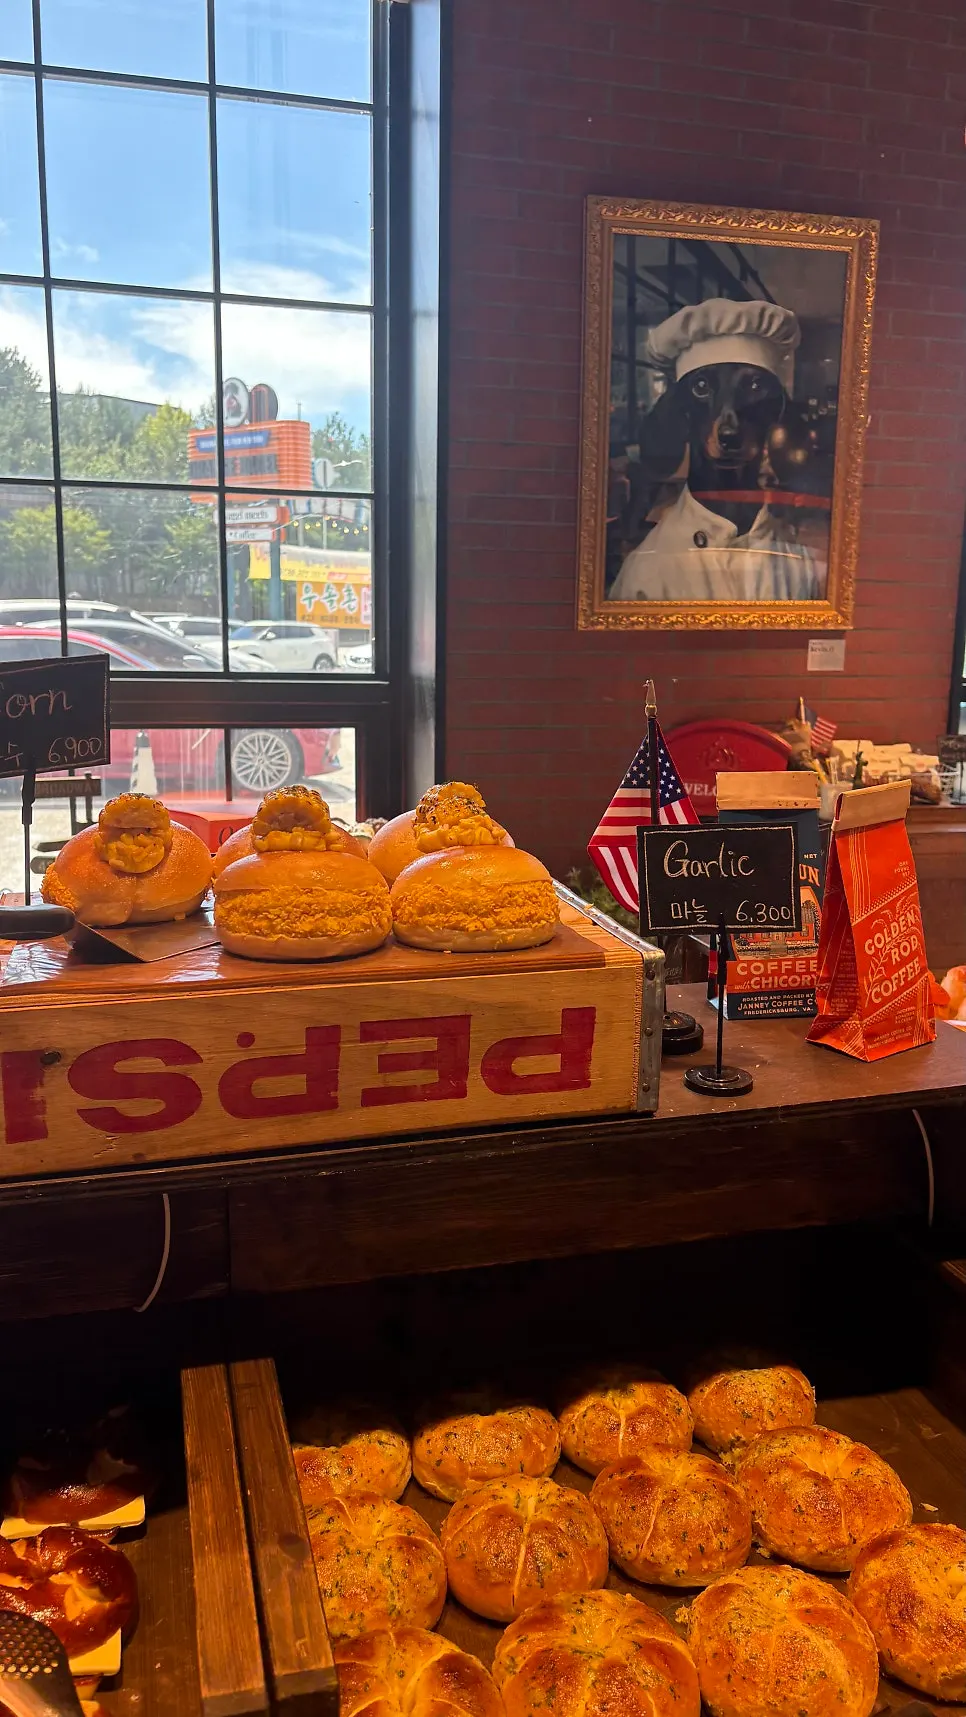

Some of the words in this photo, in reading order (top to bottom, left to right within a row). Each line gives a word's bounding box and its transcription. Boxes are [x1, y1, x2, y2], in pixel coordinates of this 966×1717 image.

[0, 689, 73, 719] orn
[48, 736, 101, 763] 6,900
[663, 840, 755, 878] Garlic
[670, 898, 708, 923] 마늘
[864, 908, 916, 955] GOLDEN
[891, 934, 919, 965] ROD
[736, 960, 818, 976] COFFEE
[871, 956, 921, 1004] COFFEE
[734, 980, 750, 990] with
[738, 1001, 769, 1011] JANNEY
[771, 999, 804, 1008] COFFEE
